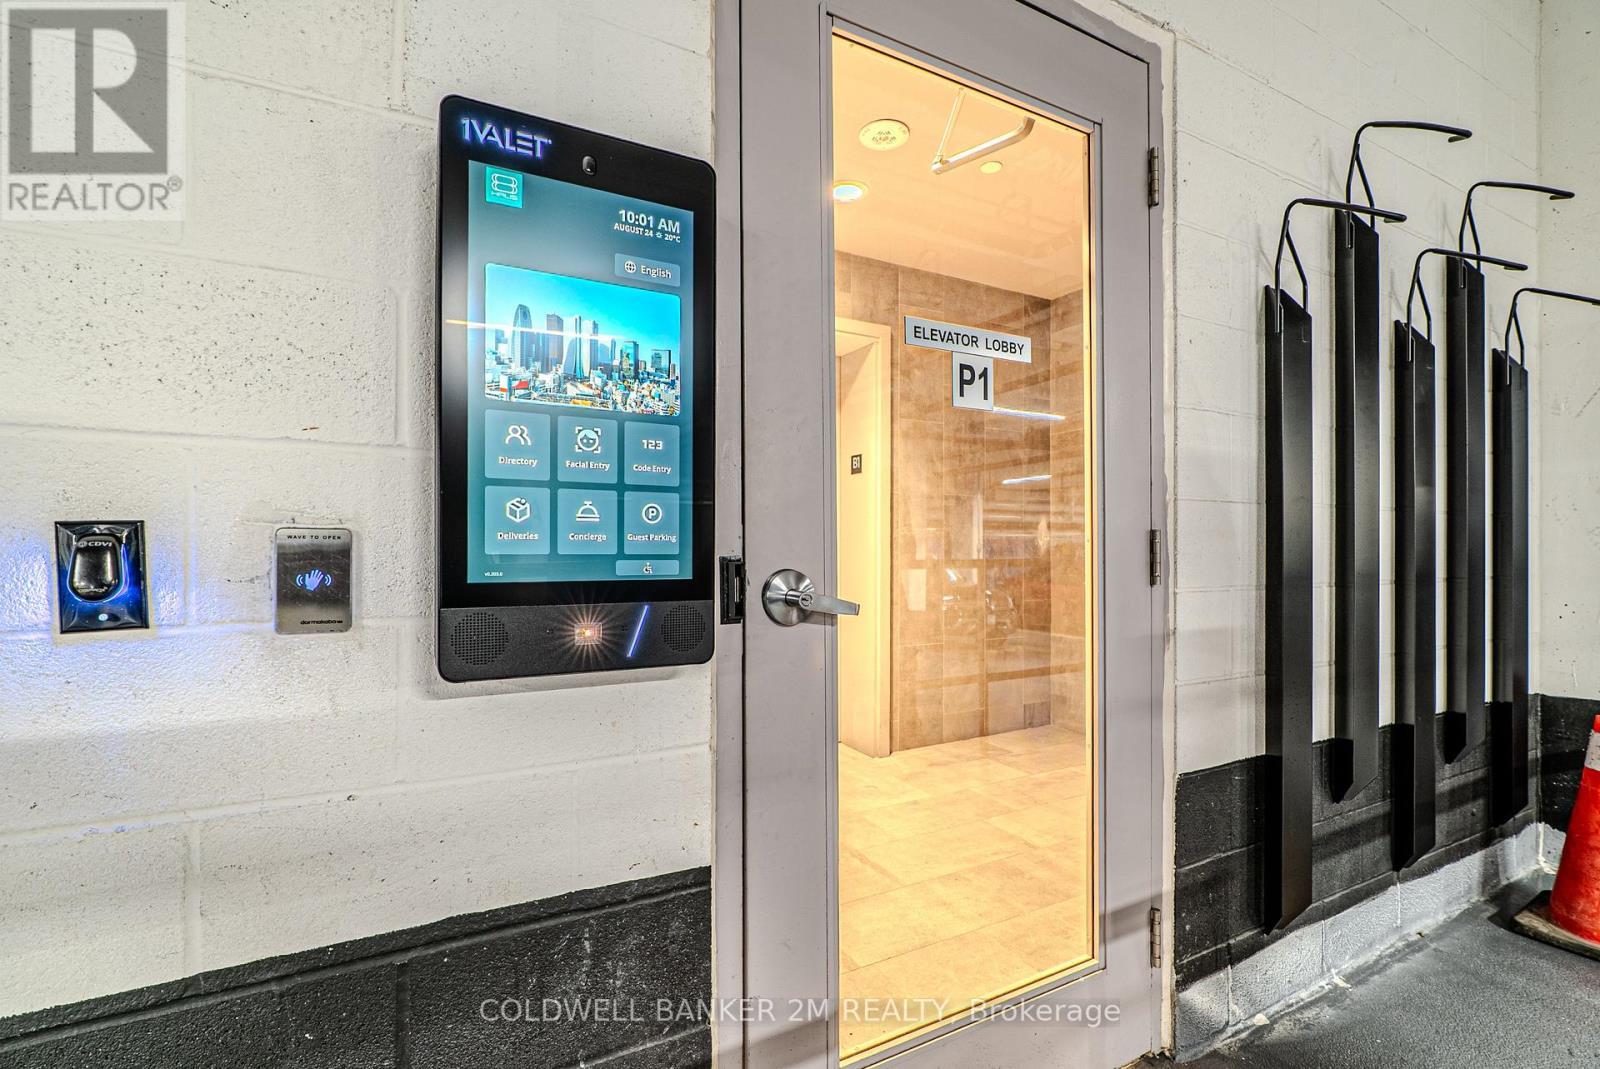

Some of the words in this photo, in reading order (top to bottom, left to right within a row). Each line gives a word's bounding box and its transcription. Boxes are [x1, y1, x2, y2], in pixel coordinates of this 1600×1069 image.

[461, 117, 546, 158] 1VALET
[619, 209, 654, 228] 10:01
[658, 218, 680, 234] AM
[614, 223, 643, 235] AUGUST
[644, 229, 653, 237] 24
[641, 265, 672, 279] English
[913, 325, 979, 348] ELEVATOR
[985, 338, 1025, 356] LOBBY
[959, 363, 989, 400] P1
[642, 439, 663, 450] 123
[498, 456, 538, 467] Directory
[566, 460, 589, 469] Facial
[590, 461, 610, 471] Entry
[633, 464, 651, 472] Code
[652, 465, 672, 474] Entry
[498, 531, 538, 540] Deliveries
[569, 532, 607, 541] Concierge
[627, 533, 649, 541] Guest
[650, 533, 677, 543] Parking
